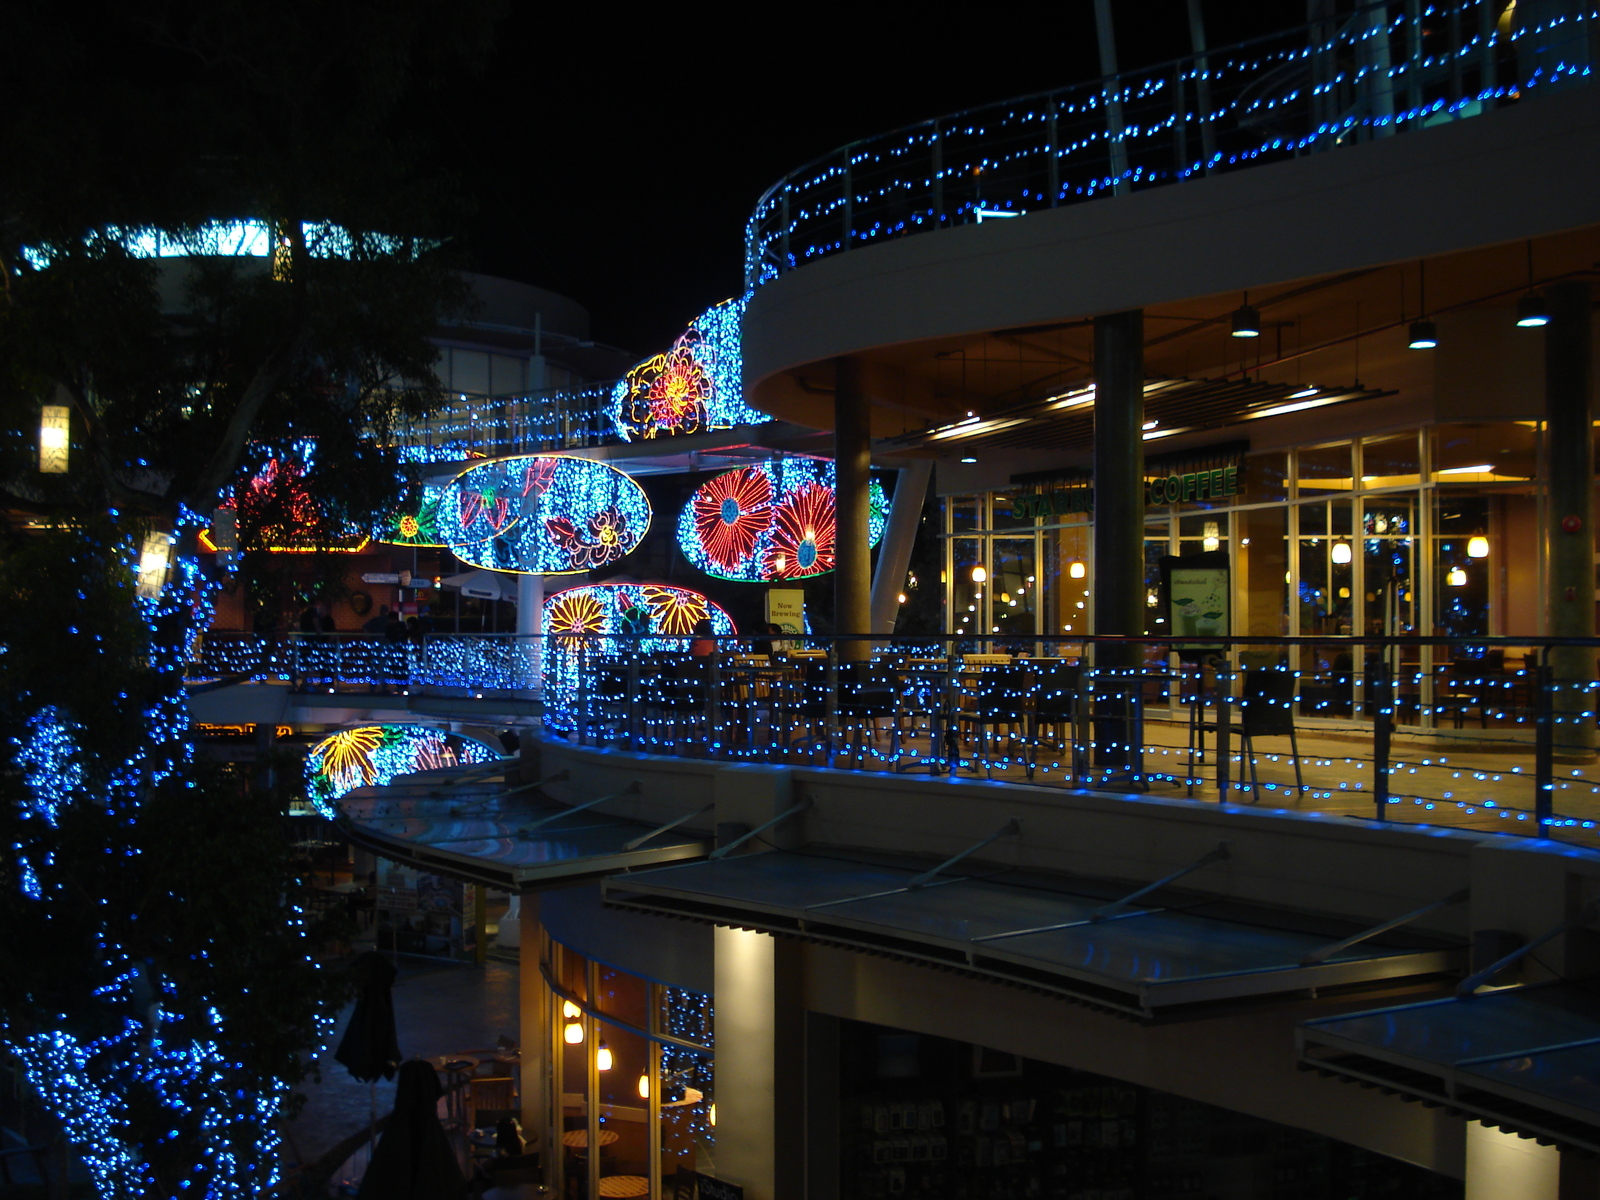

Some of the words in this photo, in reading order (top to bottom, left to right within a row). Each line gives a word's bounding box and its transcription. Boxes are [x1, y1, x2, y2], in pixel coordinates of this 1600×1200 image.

[1012, 488, 1095, 520] STARBU
[1151, 466, 1238, 505] COFFEE
[771, 610, 801, 618] Brewing
